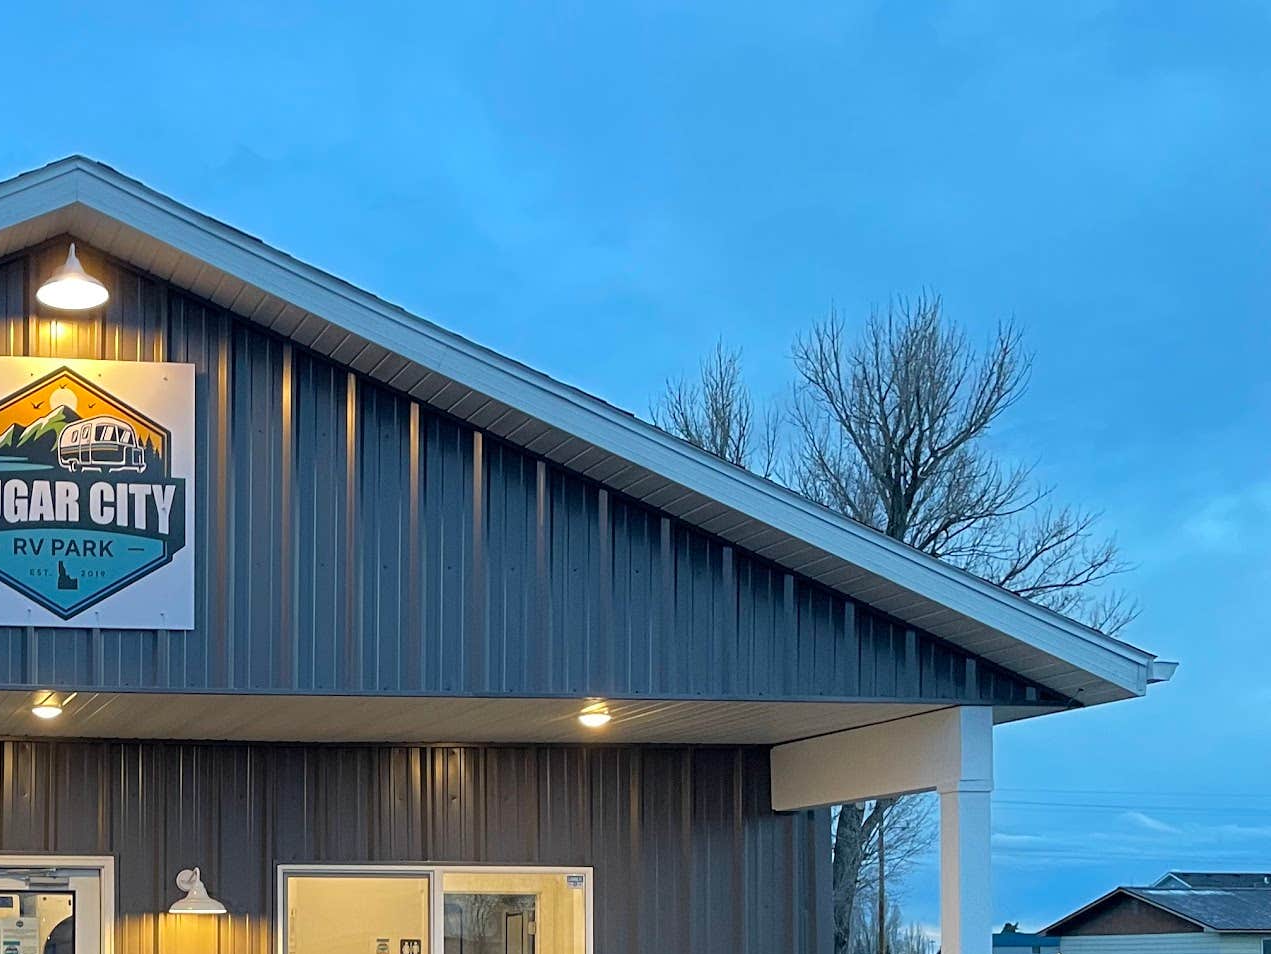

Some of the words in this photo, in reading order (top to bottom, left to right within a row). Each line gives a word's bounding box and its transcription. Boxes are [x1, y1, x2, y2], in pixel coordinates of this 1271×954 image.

[89, 481, 176, 534] CITY
[14, 537, 46, 556] RV
[52, 538, 114, 557] PARK
